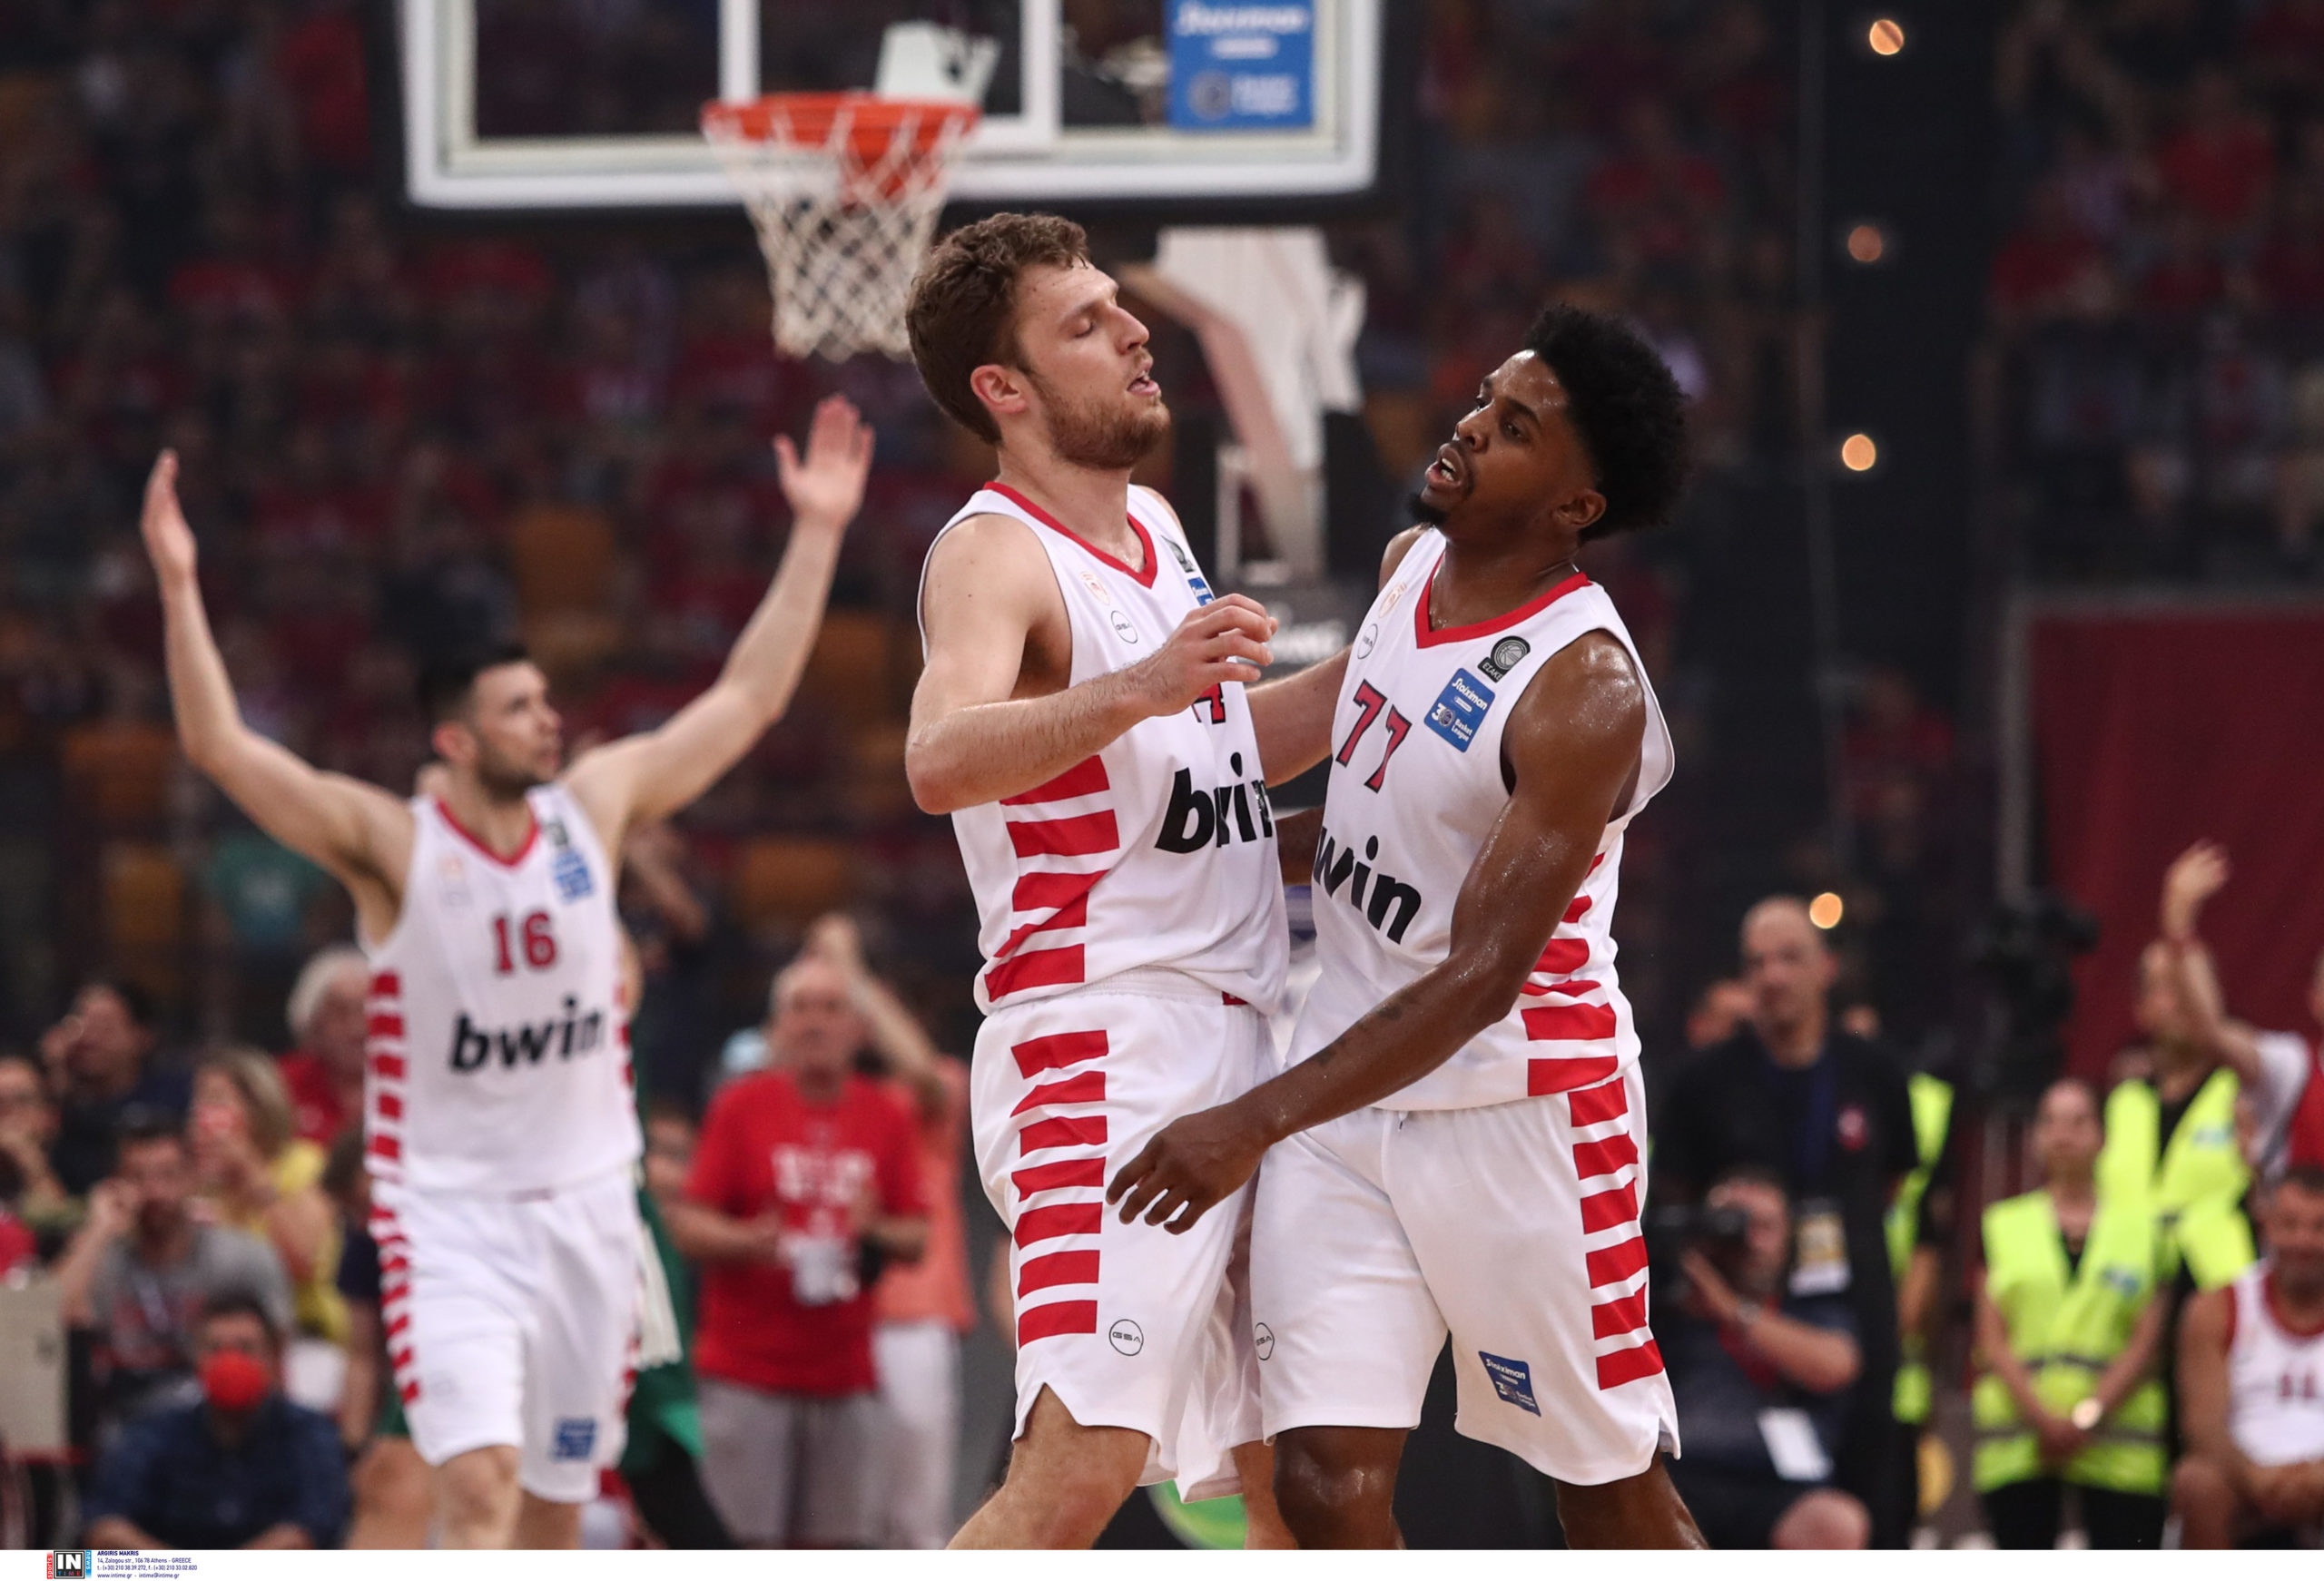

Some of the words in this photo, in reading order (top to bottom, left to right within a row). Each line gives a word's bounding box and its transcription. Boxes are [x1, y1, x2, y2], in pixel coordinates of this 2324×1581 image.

[1190, 682, 1226, 725] 4
[1452, 677, 1488, 711] Stoiximan
[1335, 678, 1413, 794] 77
[1313, 825, 1422, 946] win
[492, 910, 557, 976] 16
